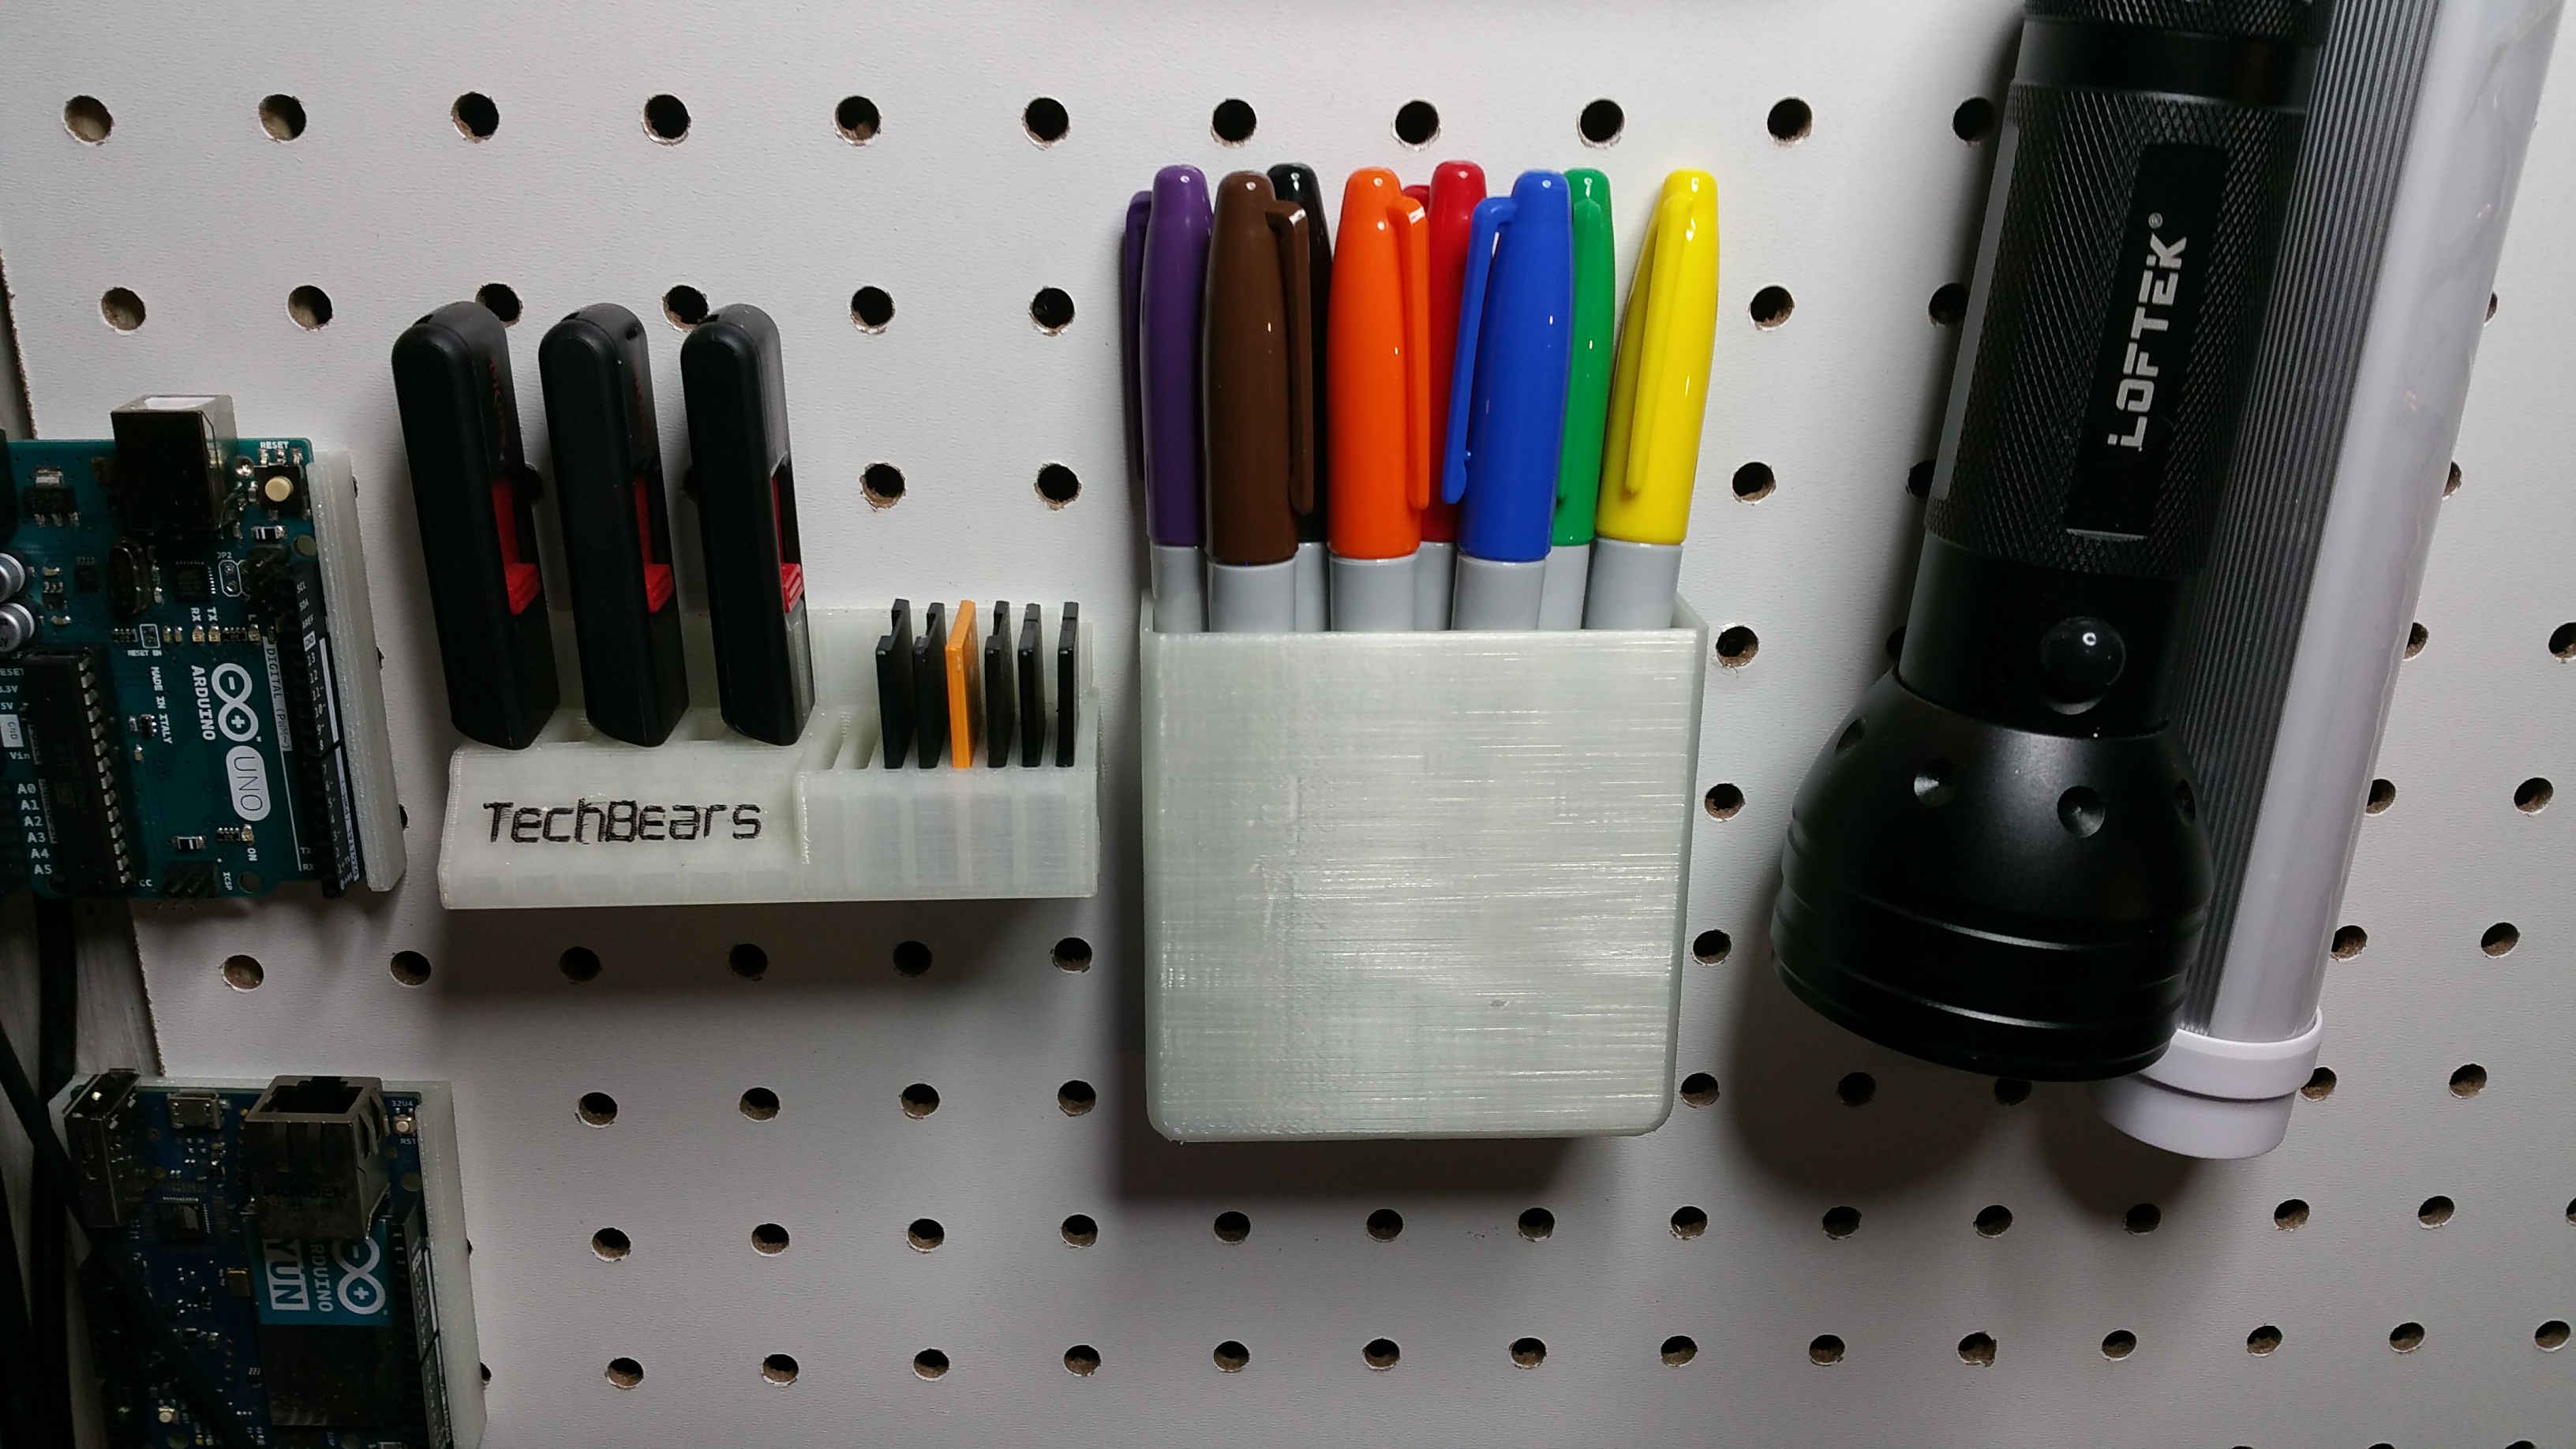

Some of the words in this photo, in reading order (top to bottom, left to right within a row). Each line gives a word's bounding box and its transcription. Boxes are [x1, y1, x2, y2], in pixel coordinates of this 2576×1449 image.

[2108, 233, 2187, 452] LOFTEK
[260, 440, 289, 450] RESET
[190, 607, 202, 623] RX
[207, 606, 219, 623] TX
[306, 653, 316, 667] 13
[150, 666, 163, 691] MADE
[266, 647, 283, 699] DIGITAL
[309, 669, 318, 684] 12
[155, 695, 167, 710] IN
[190, 665, 216, 741] ARDUINO
[159, 713, 173, 744] ITALY
[9, 751, 31, 761] Vin
[17, 783, 36, 795] A0
[234, 756, 264, 812] UNO
[21, 799, 40, 811] A1
[24, 815, 43, 827] A2
[483, 798, 763, 844] TechBears
[27, 831, 47, 843] A3
[30, 848, 50, 859] A4
[247, 847, 258, 862] ON
[34, 864, 53, 875] A5
[223, 871, 233, 891] ICSP
[310, 1241, 335, 1312] RDUINO
